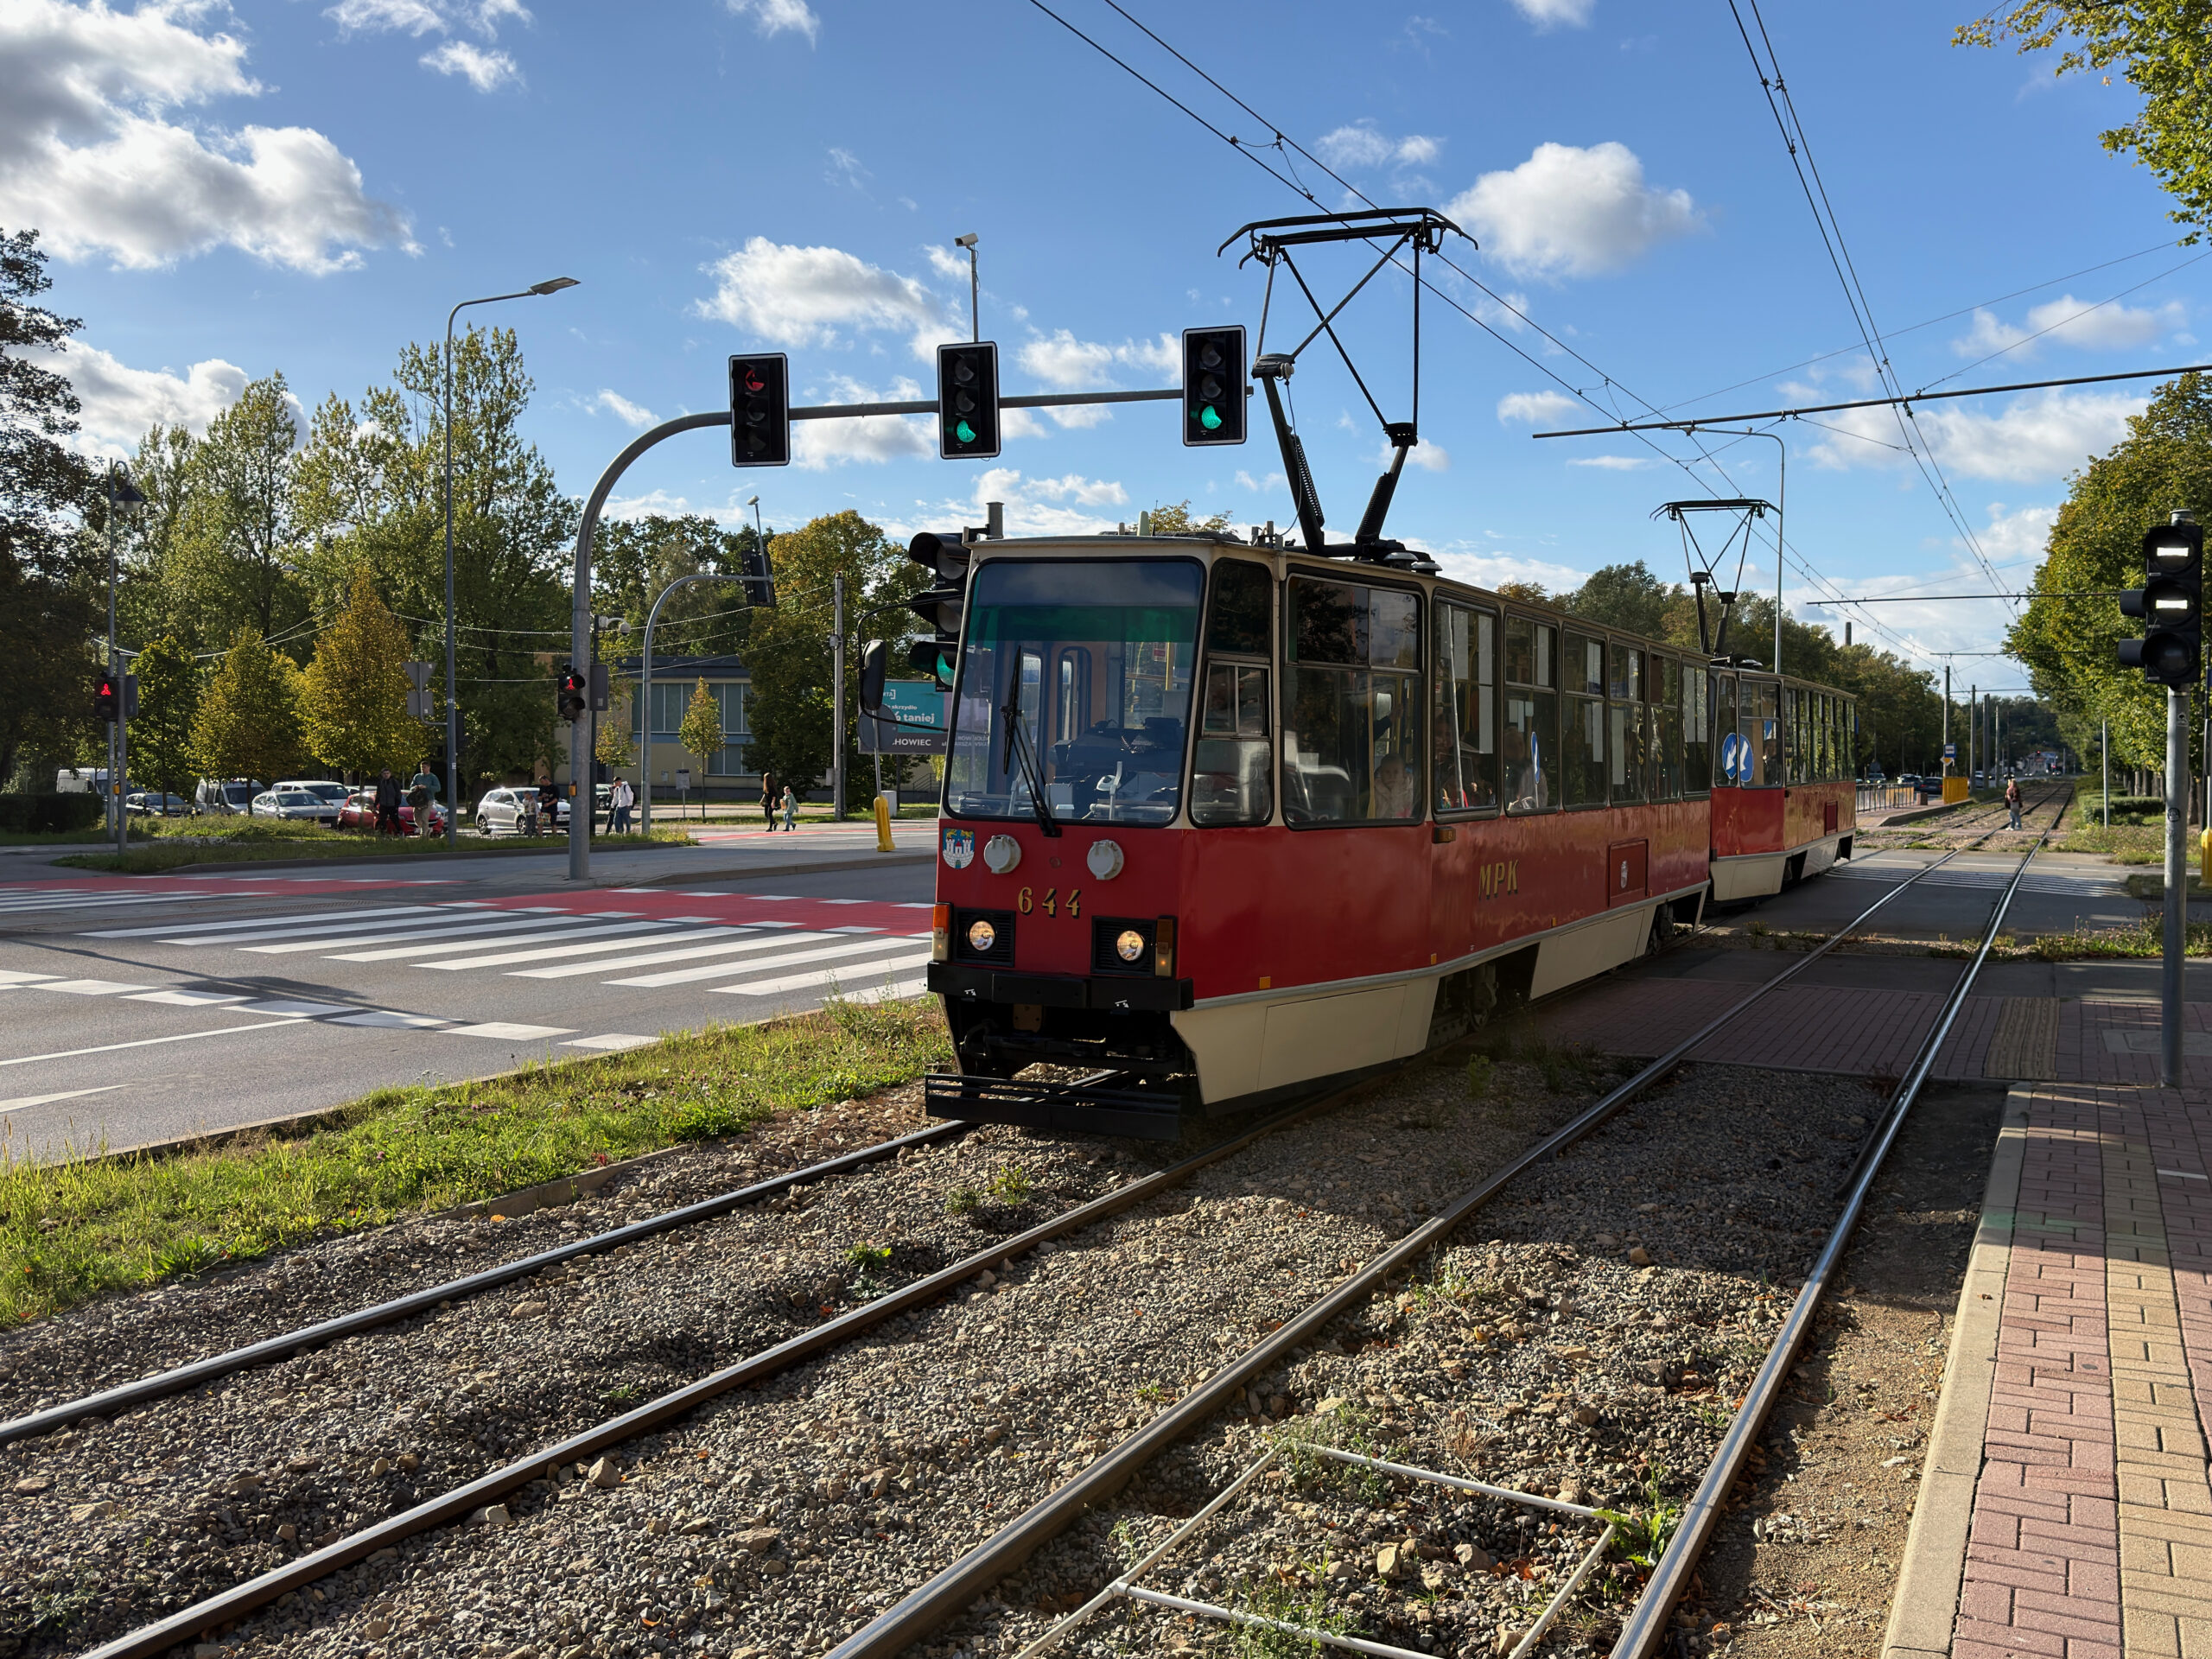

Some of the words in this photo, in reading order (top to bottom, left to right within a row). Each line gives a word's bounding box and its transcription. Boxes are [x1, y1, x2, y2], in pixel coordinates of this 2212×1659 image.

[903, 713, 935, 724] taniej
[892, 738, 931, 747] HOWIEC
[1478, 859, 1519, 899] MPK
[1018, 887, 1080, 918] 644
